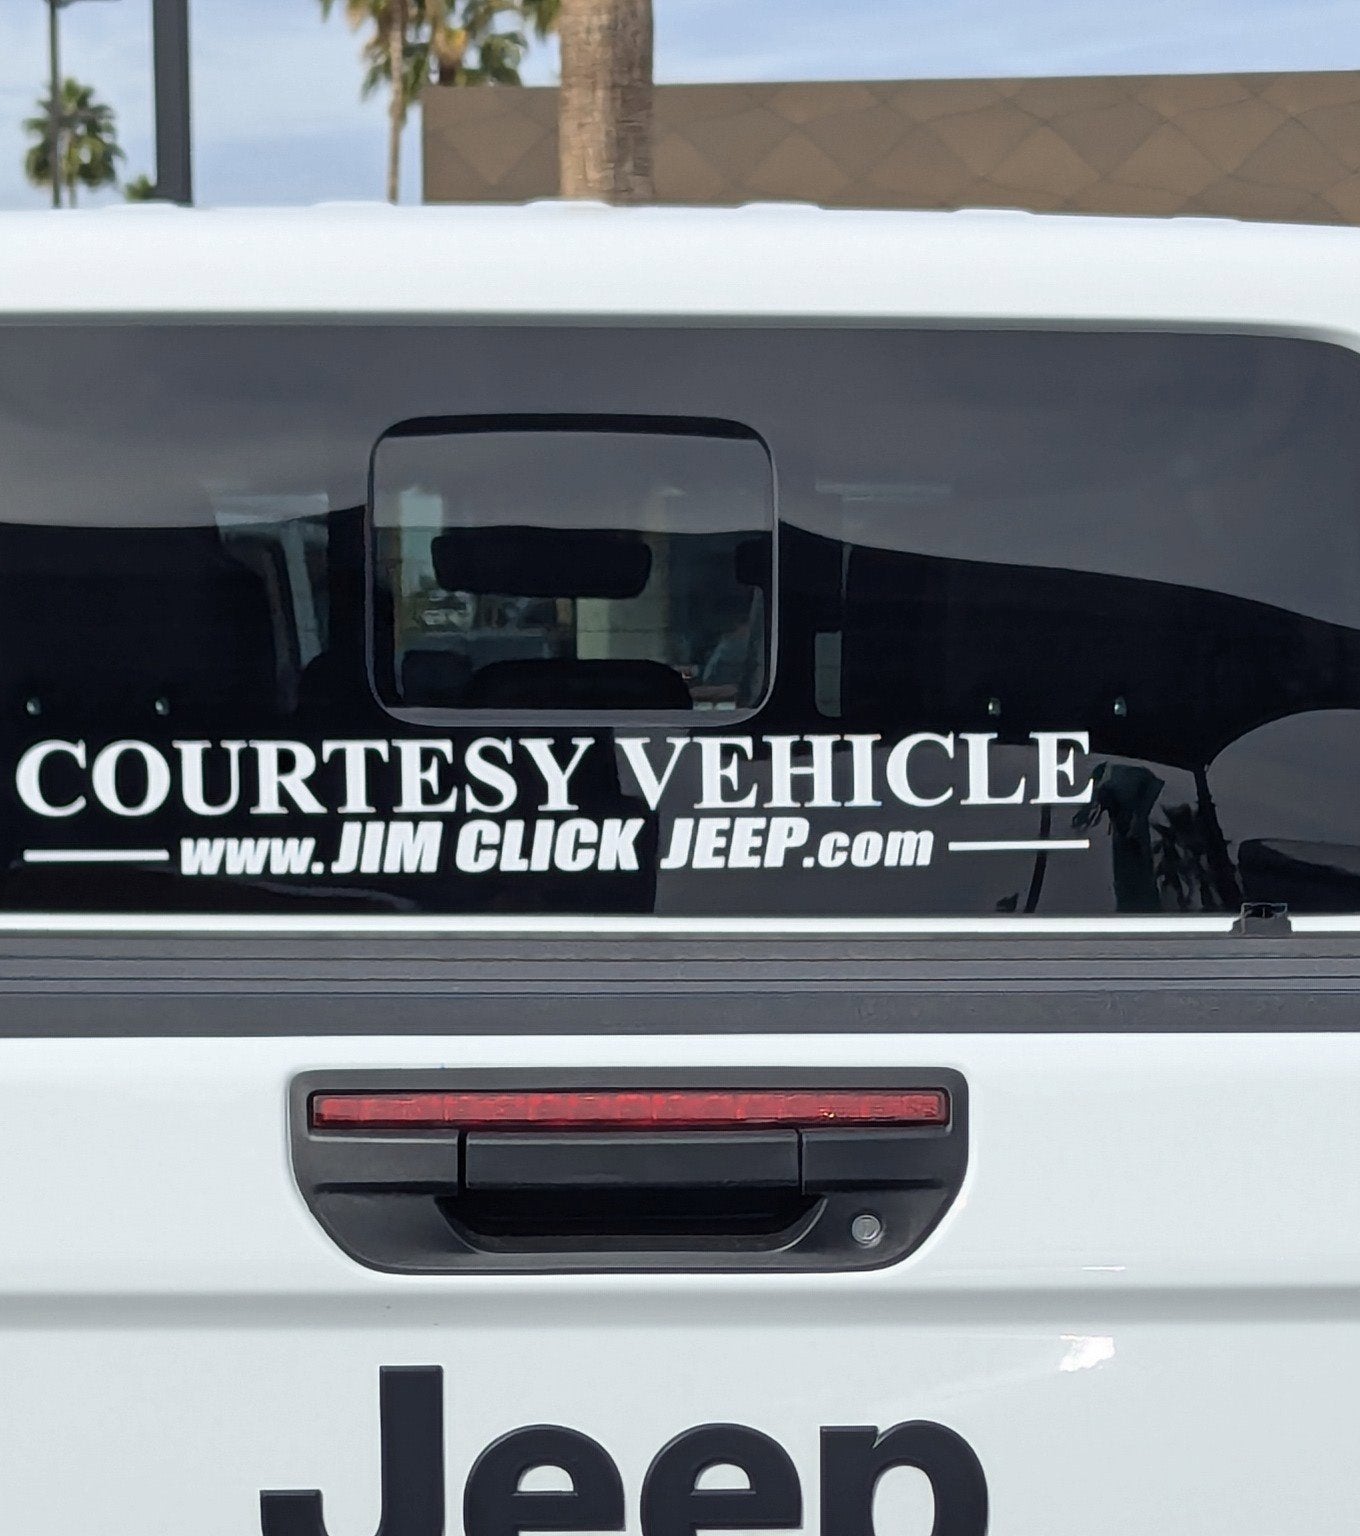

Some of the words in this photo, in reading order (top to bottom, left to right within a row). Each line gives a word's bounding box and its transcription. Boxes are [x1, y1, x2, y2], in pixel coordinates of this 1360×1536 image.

[15, 736, 595, 817] COURTESY
[614, 730, 1095, 811] VEHICLE
[455, 817, 645, 873] CLICK
[660, 815, 935, 870] JEEP.com
